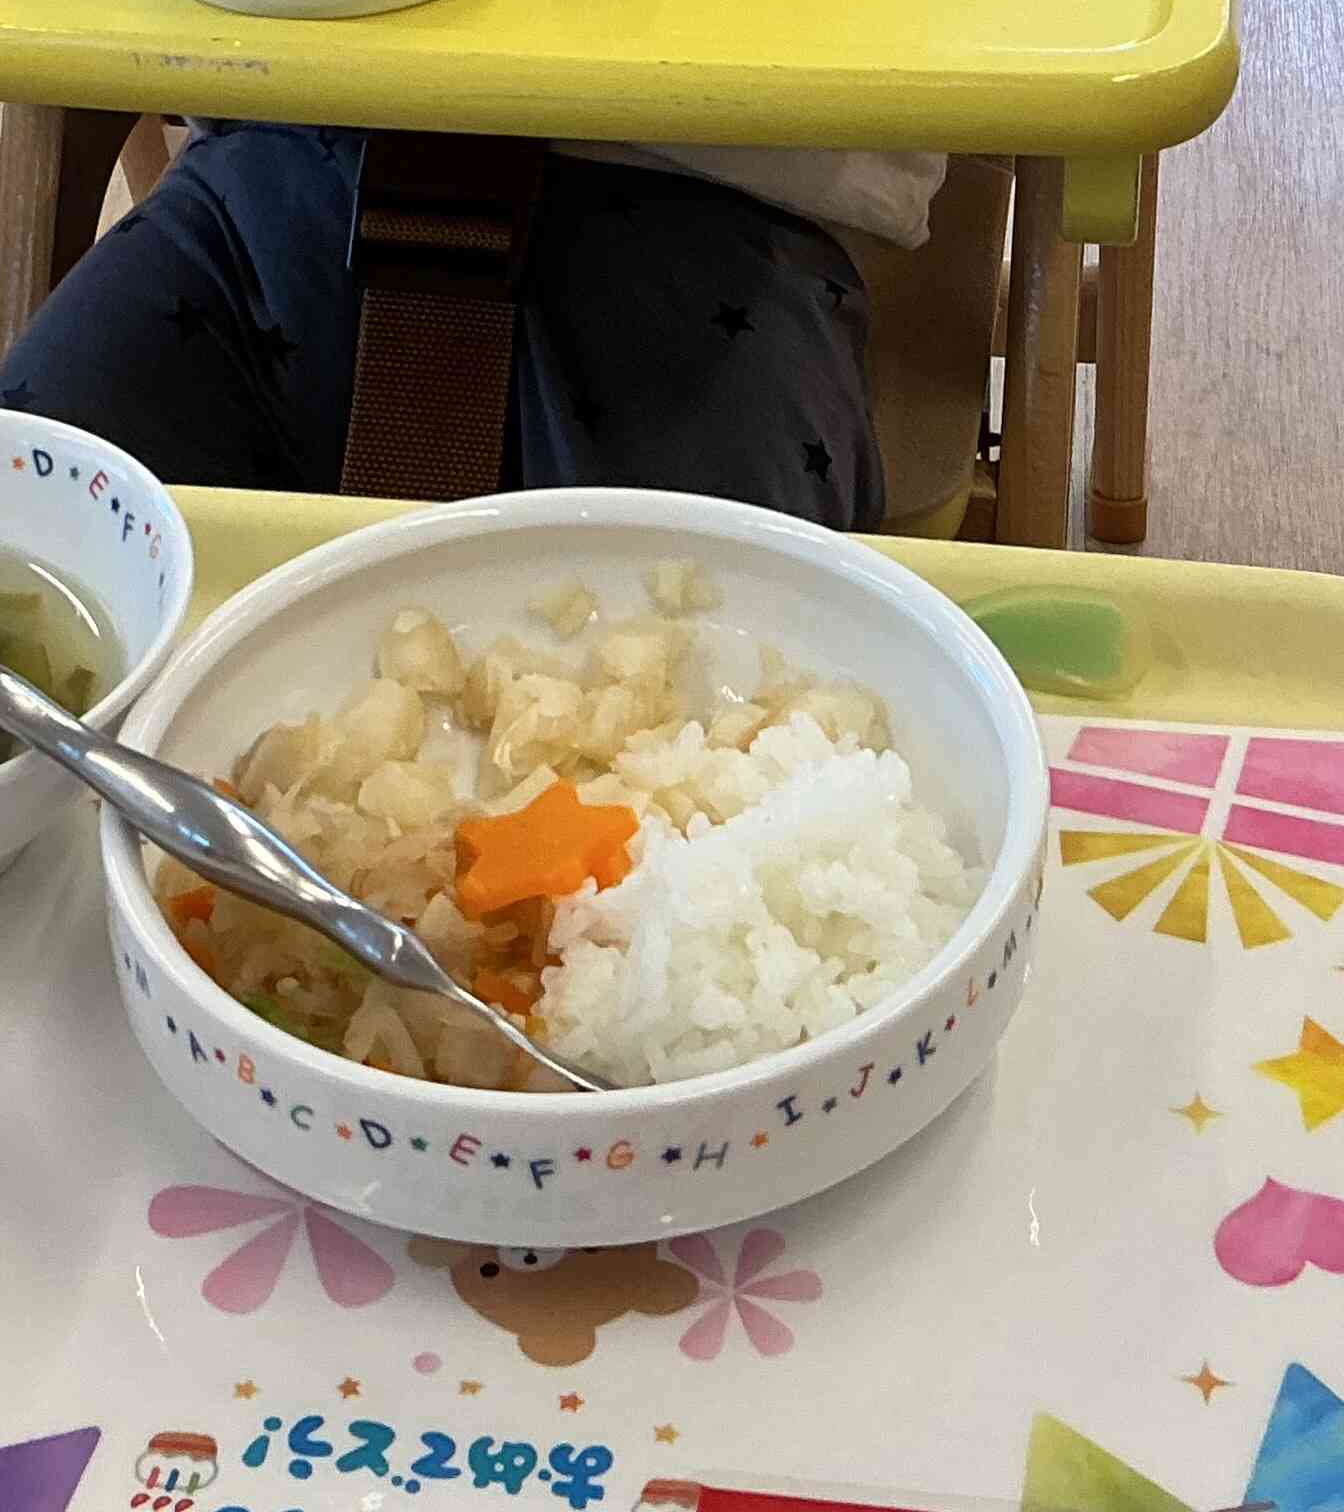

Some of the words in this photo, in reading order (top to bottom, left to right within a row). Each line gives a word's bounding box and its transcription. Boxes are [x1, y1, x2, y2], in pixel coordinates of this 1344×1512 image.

[32, 449, 54, 477] D
[88, 470, 110, 501] E
[122, 512, 135, 542] F
[189, 1030, 208, 1063] A
[237, 1052, 256, 1085] B
[290, 1104, 315, 1131] C
[359, 1117, 392, 1149] D
[449, 1133, 482, 1166] E
[529, 1158, 555, 1190] F
[606, 1139, 634, 1170] G
[692, 1140, 729, 1171] H
[776, 1095, 803, 1126] I
[849, 1062, 874, 1098] J
[916, 1030, 937, 1066] K
